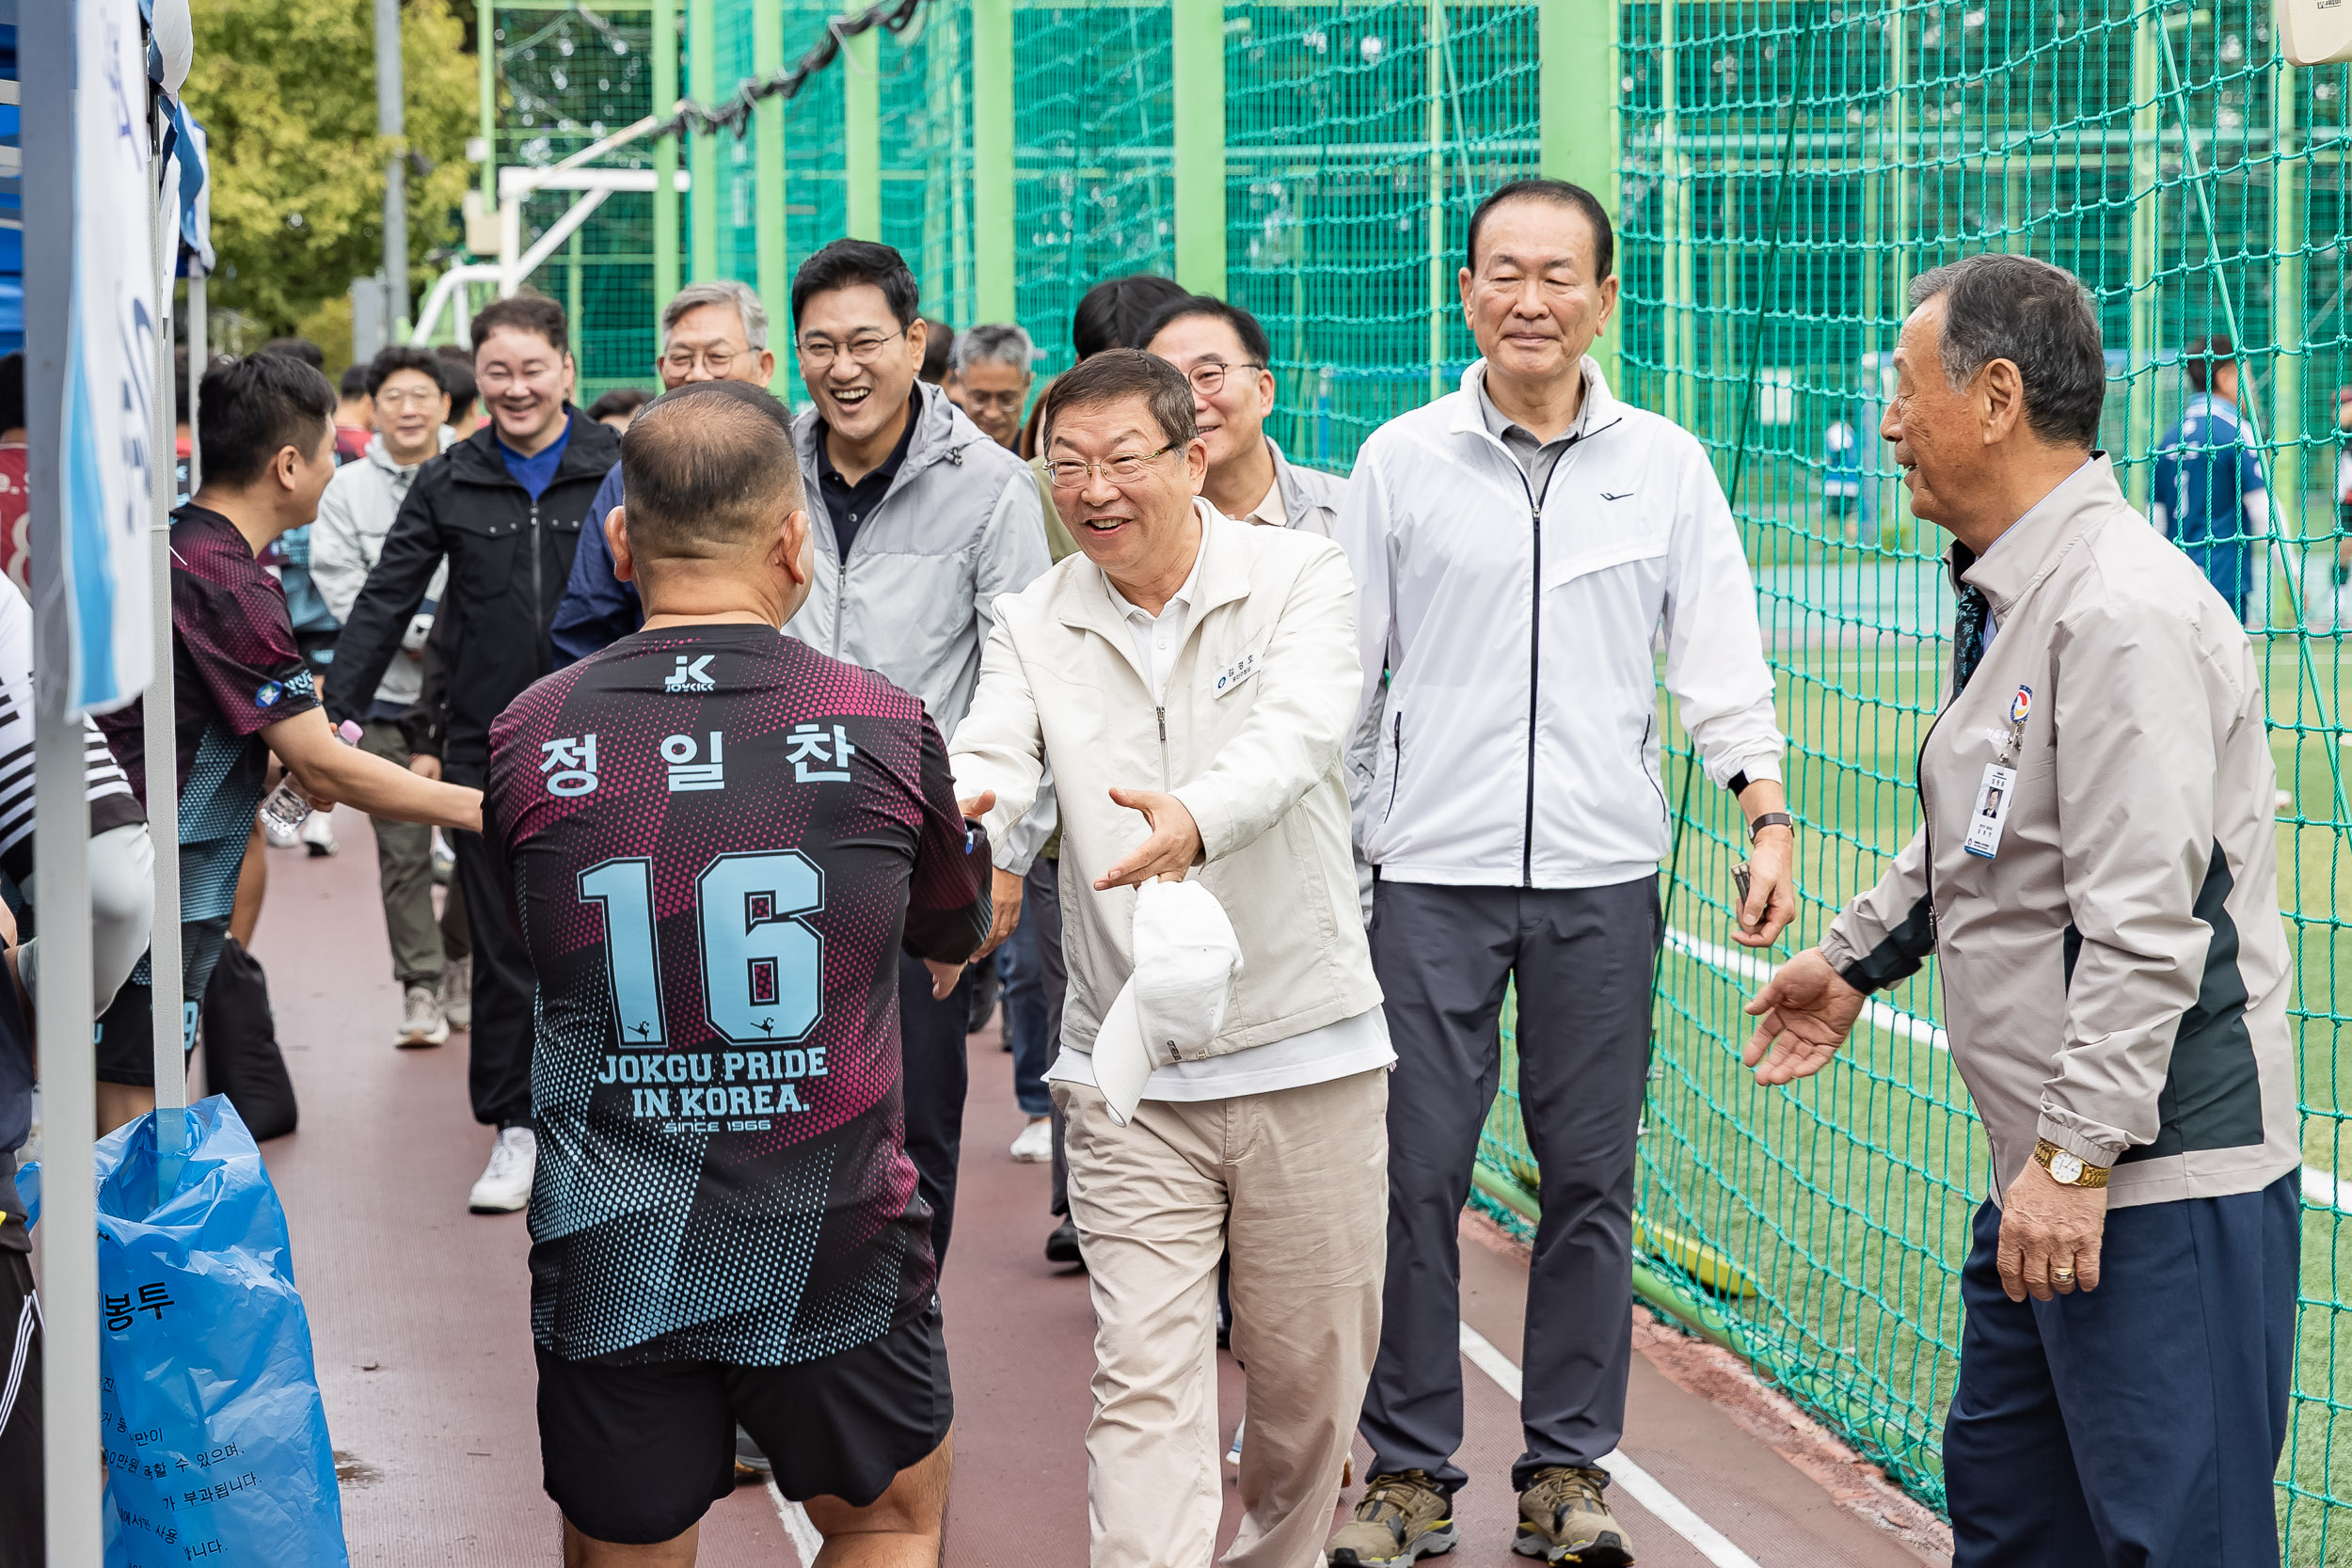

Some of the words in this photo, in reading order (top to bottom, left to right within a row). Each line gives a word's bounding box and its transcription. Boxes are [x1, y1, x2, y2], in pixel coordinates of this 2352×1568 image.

[541, 734, 598, 797] 정
[660, 731, 725, 792] 일
[786, 723, 856, 784] 찬
[577, 848, 825, 1049] 16
[598, 1053, 712, 1084] JOKGU
[723, 1047, 828, 1081] PRIDE
[632, 1088, 670, 1117] IN
[679, 1084, 810, 1117] KOREA.
[726, 1119, 771, 1132] 1966
[129, 1427, 164, 1448] 만이
[175, 1458, 189, 1473] 수
[197, 1442, 245, 1469] 있으며,
[183, 1471, 263, 1507] 부과됩니다.
[155, 1524, 178, 1544] 사용
